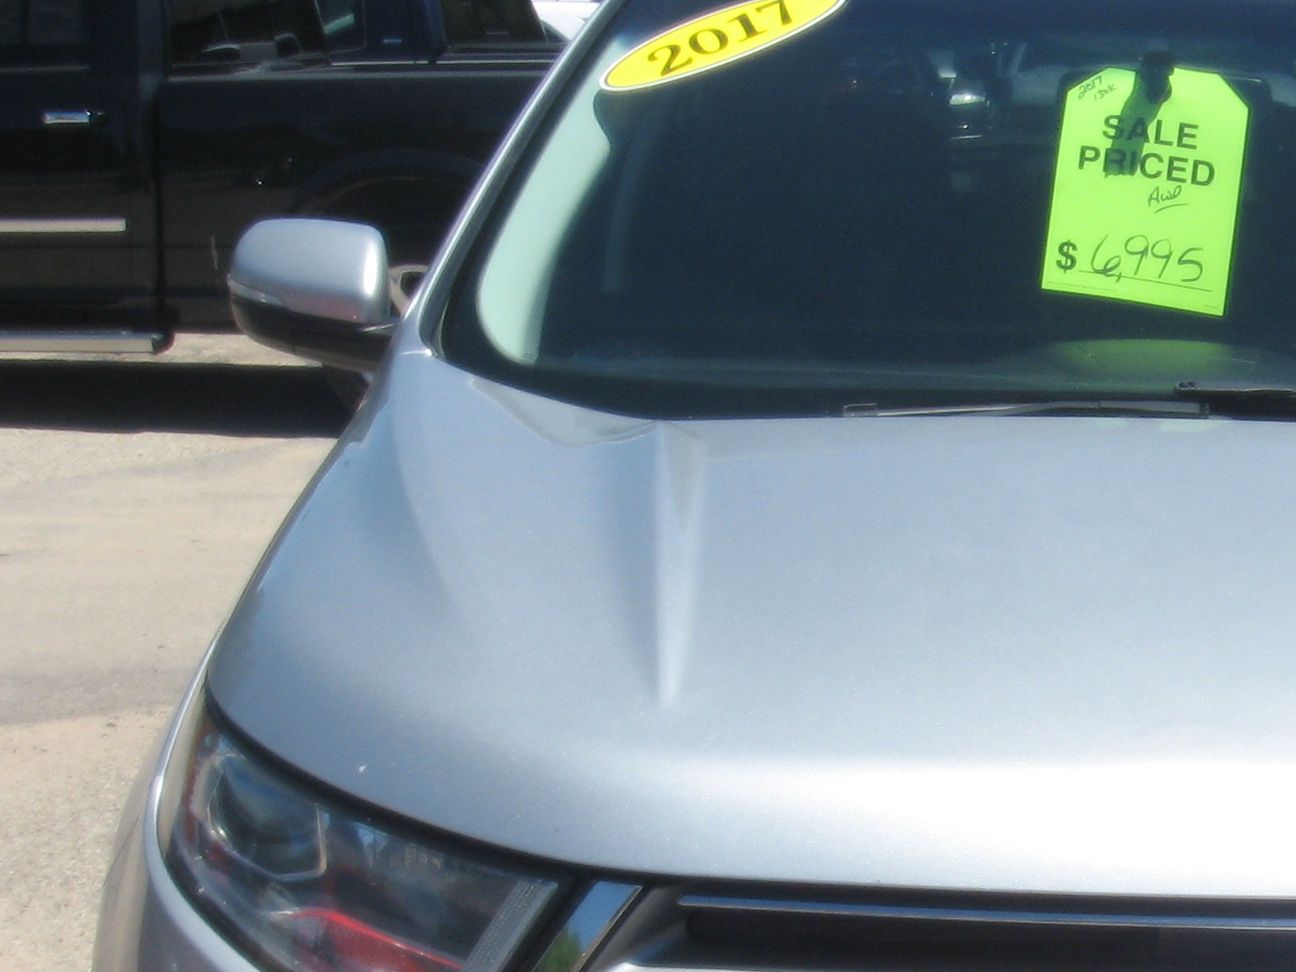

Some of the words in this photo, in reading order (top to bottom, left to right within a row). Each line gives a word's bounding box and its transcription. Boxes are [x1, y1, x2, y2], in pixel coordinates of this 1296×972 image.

[647, 0, 792, 76] 2017
[1102, 114, 1199, 150] SALE
[1078, 145, 1216, 187] PRICED
